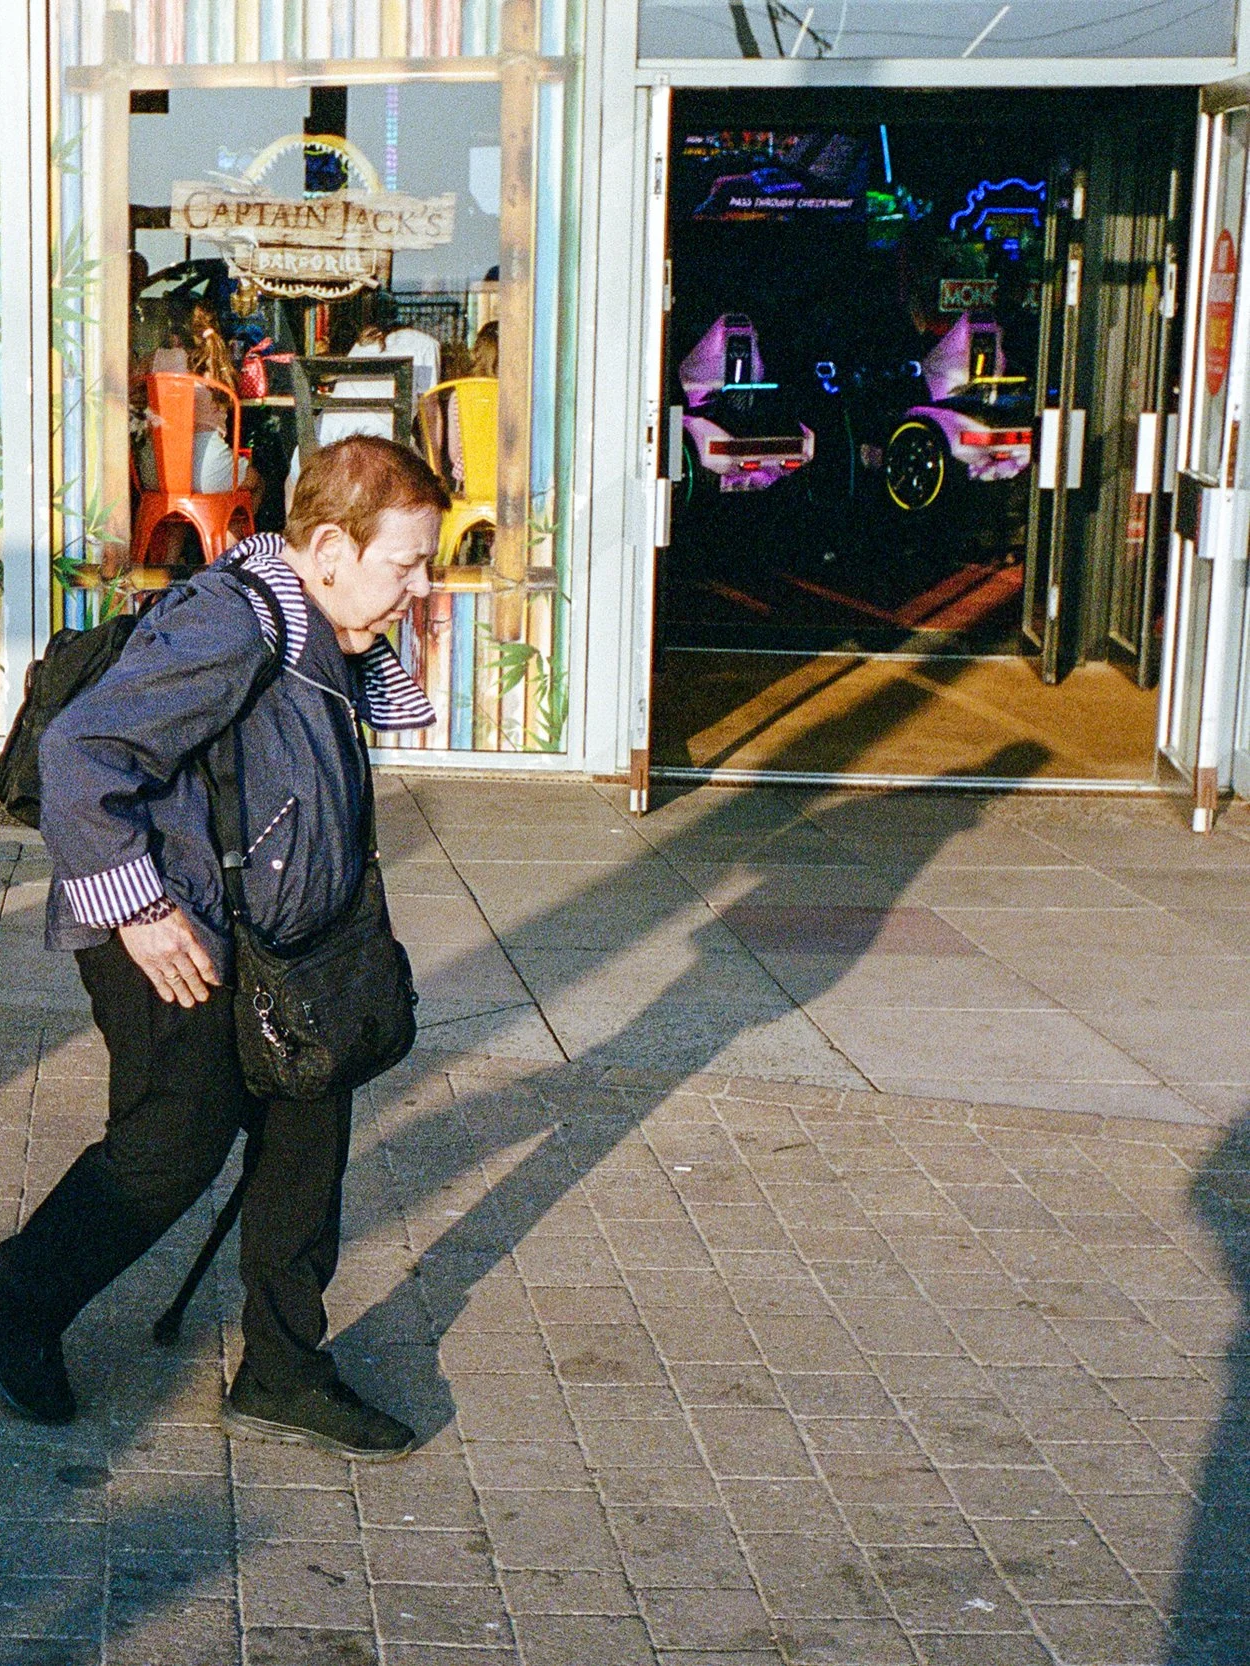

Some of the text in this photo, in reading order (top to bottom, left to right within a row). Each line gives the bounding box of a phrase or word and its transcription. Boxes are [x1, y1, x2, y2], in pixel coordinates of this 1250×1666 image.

[183, 191, 443, 240] CAPTAIN JACK'S
[258, 251, 299, 274] BAR
[310, 251, 366, 277] GRILL
